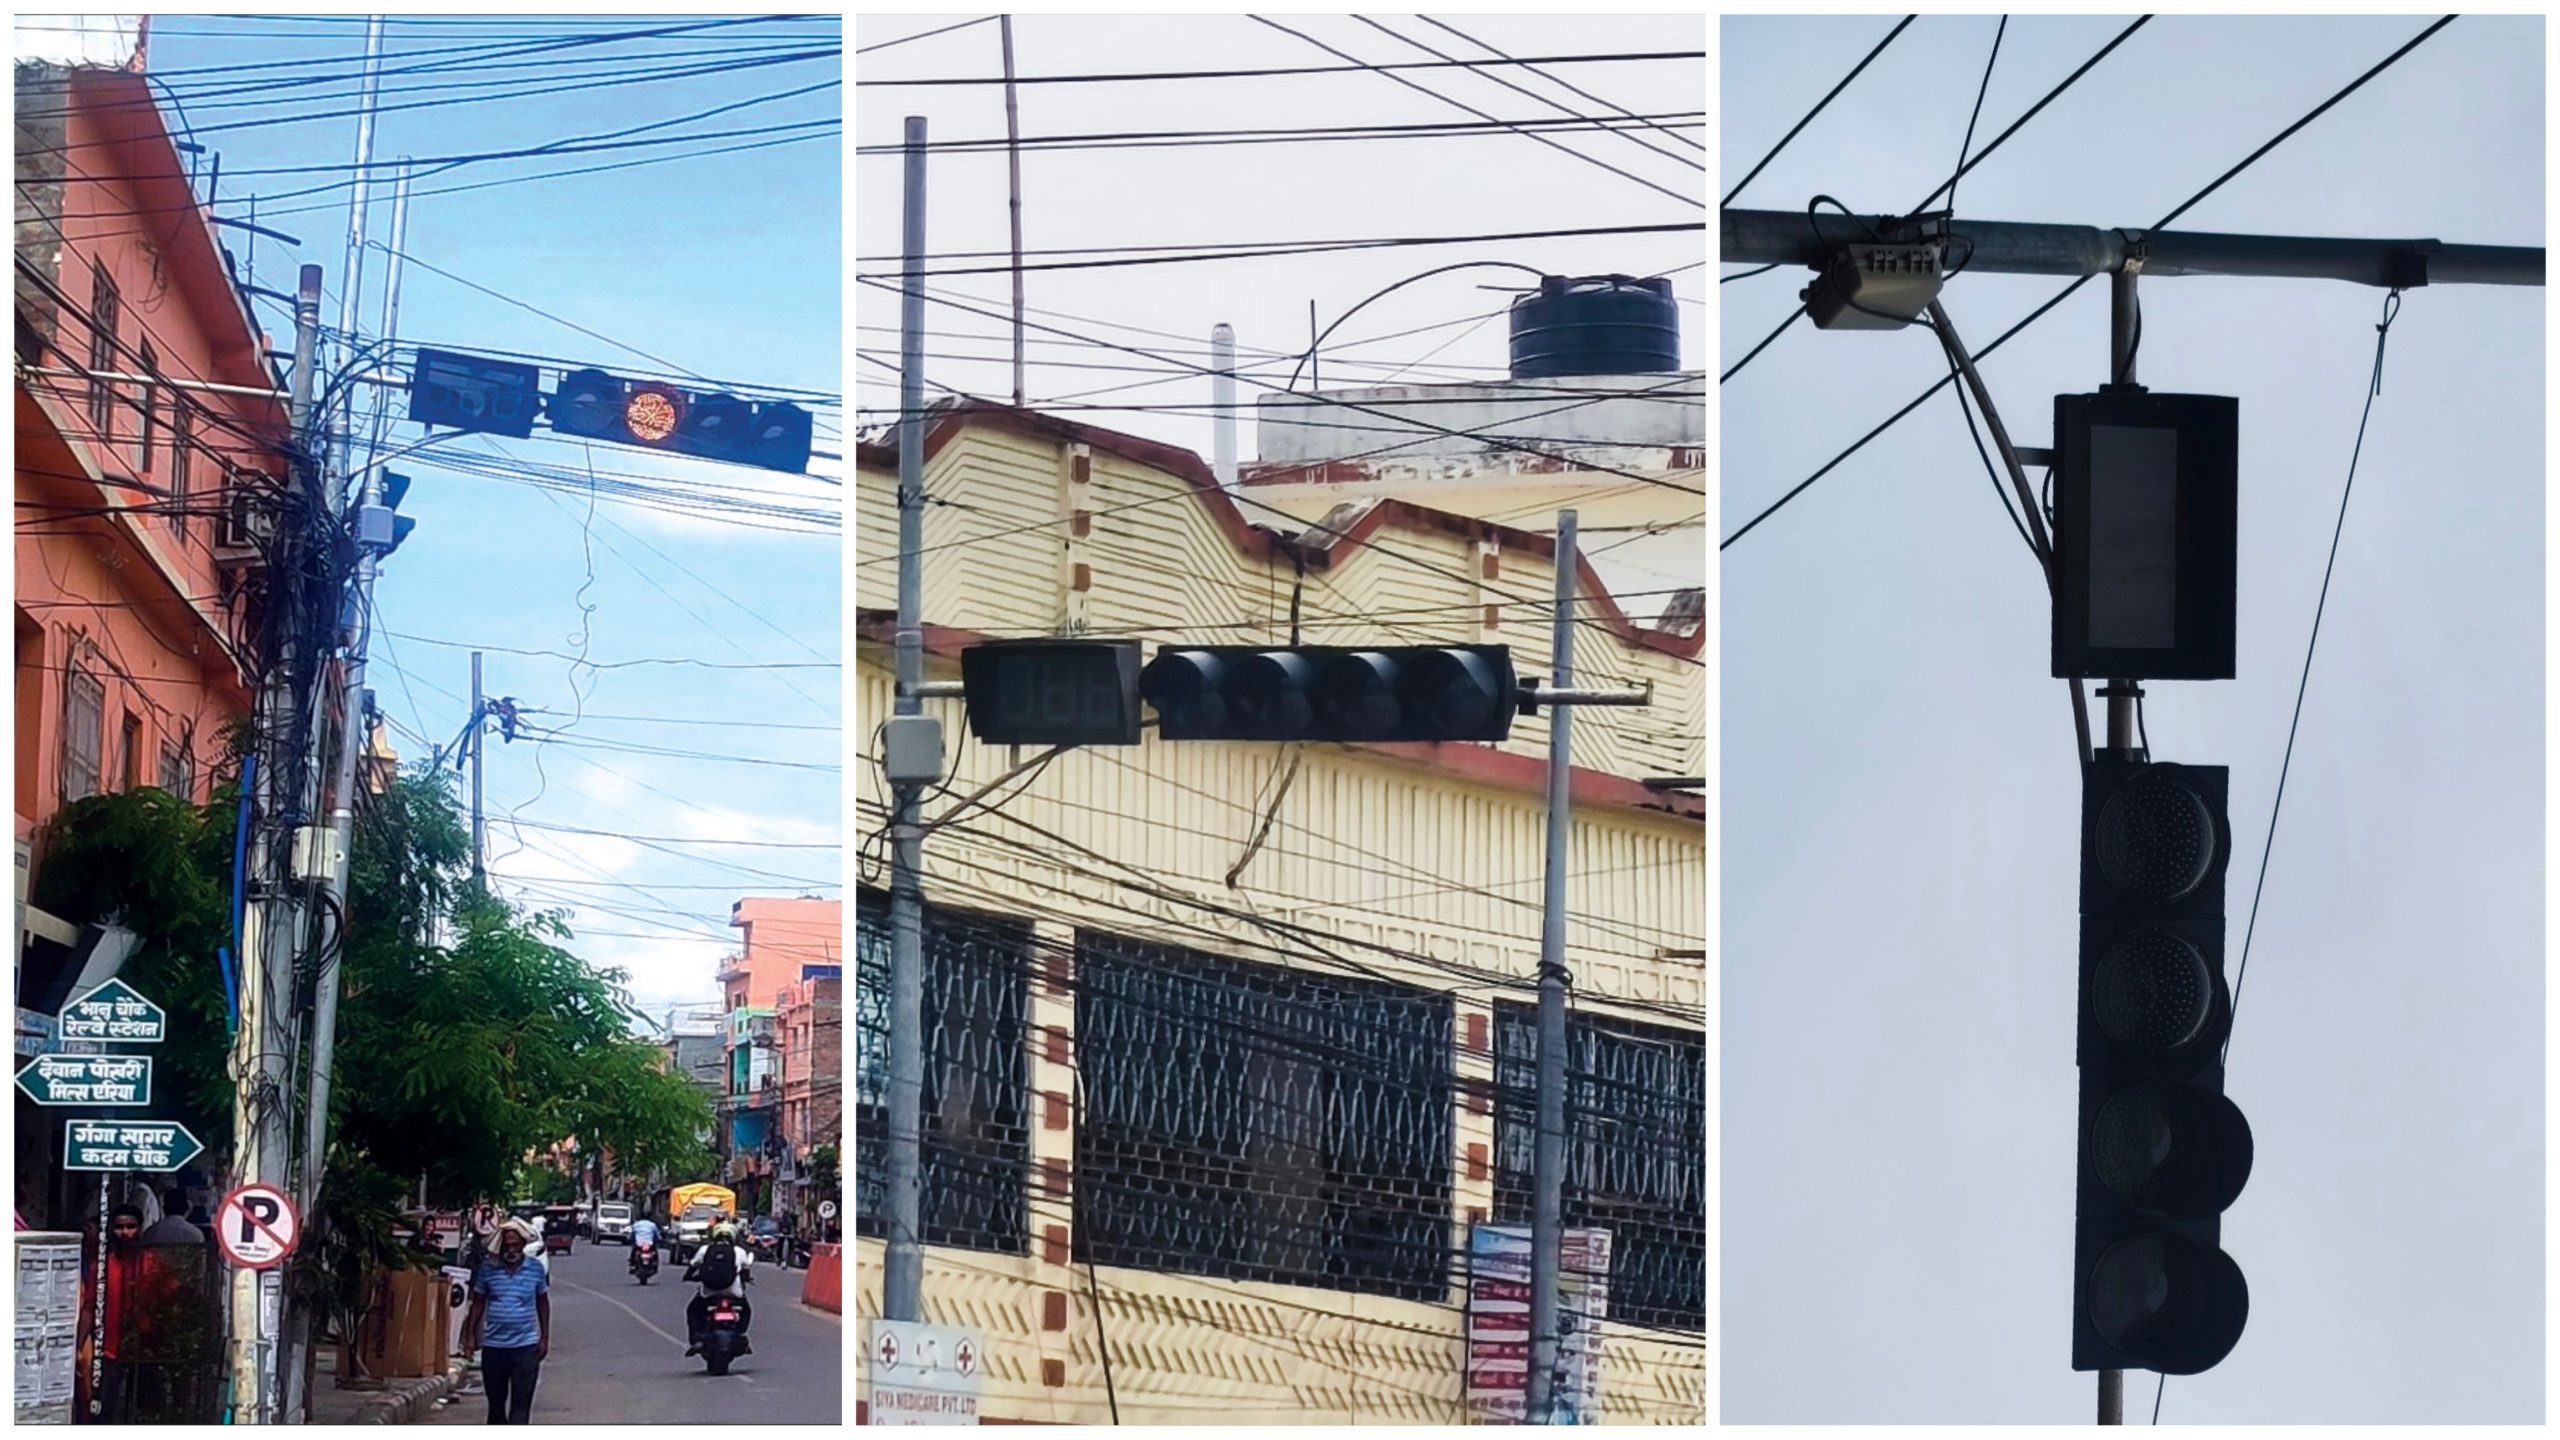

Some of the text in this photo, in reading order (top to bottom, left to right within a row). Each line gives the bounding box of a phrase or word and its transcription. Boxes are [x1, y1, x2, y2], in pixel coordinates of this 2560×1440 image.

[65, 1015, 159, 1037] रेल्वे स्टेशन
[38, 1058, 145, 1081] देवान पोखरी
[47, 1078, 136, 1101] मिल्स एरिया
[73, 1123, 175, 1147] गंगा सागर
[80, 1144, 171, 1166] कदम चौक
[241, 1195, 280, 1244] P
[822, 1202, 834, 1215] P
[875, 1390, 895, 1409] SIYA
[896, 1392, 940, 1413] MEDICARE
